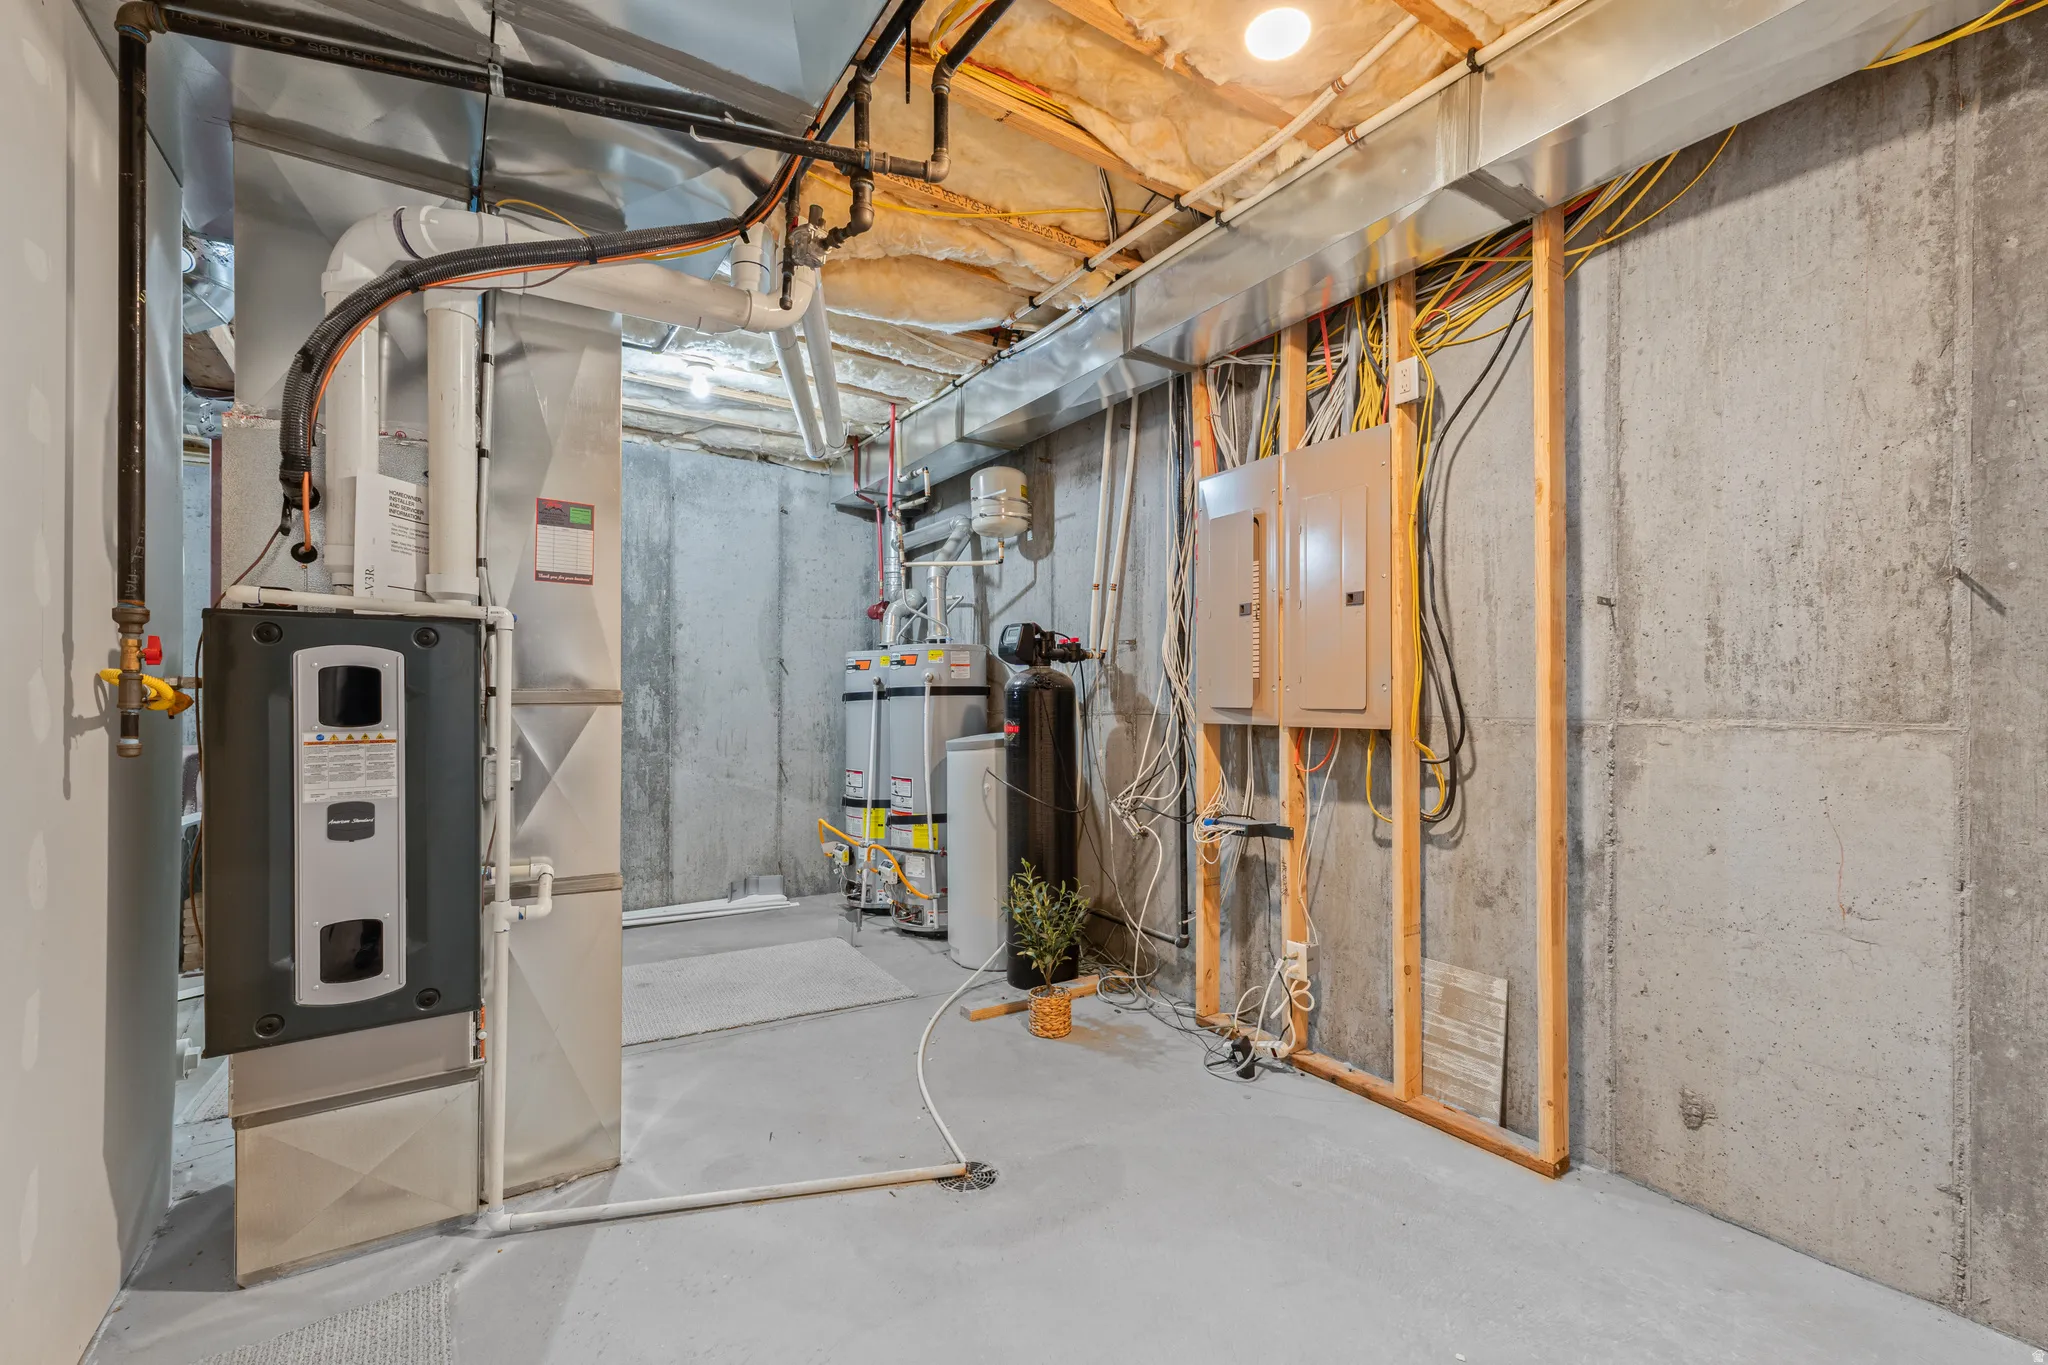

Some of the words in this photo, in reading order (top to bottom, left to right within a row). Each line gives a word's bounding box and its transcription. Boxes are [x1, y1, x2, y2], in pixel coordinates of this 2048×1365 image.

[1056, 231, 1078, 249] 13:22
[388, 489, 422, 504] HOMEOWNER,
[388, 495, 415, 507] INSTALLER
[388, 502, 401, 511] AND
[400, 505, 425, 515] SERVICER
[388, 508, 422, 521] INFORMATION
